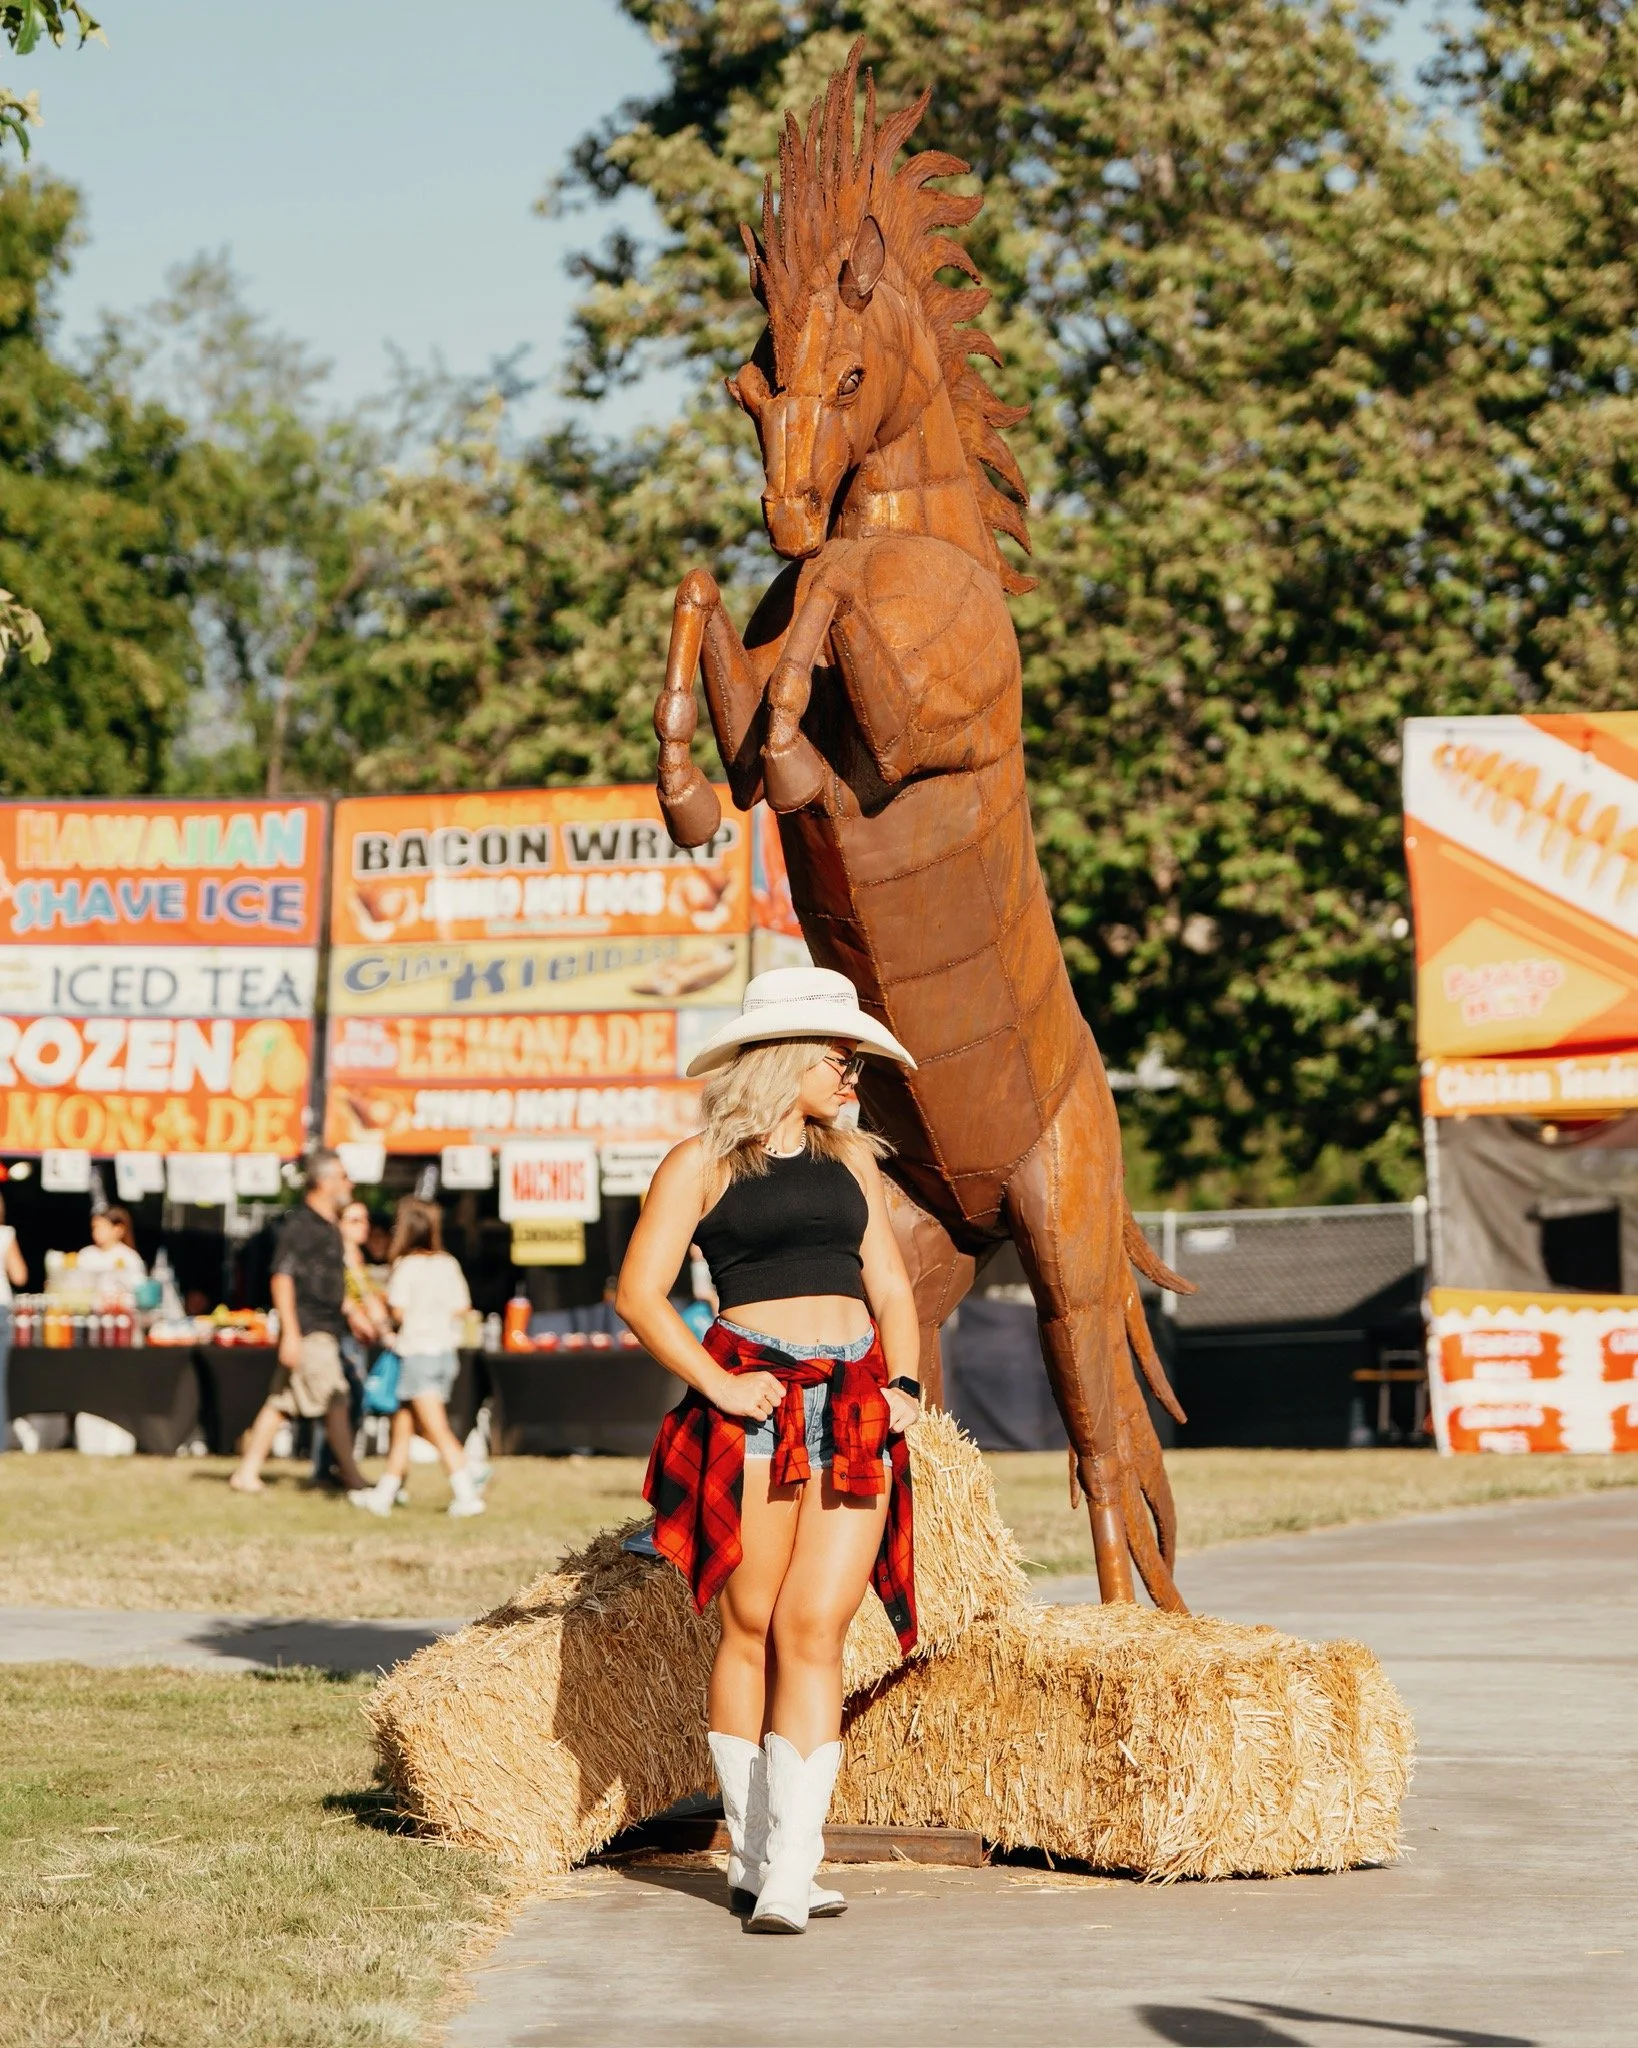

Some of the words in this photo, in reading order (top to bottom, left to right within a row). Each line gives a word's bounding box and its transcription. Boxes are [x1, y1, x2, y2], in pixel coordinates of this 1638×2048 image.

[18, 810, 304, 869] HAWAIIAN
[359, 829, 549, 872] BACON
[14, 880, 185, 931] SHAVE
[202, 881, 302, 929] ICE
[53, 965, 178, 1007] ICED
[202, 965, 301, 1008] TEA
[397, 1013, 673, 1078] LEMONADE
[2, 1093, 297, 1155] MONADE
[511, 1160, 585, 1201] NACHOS
